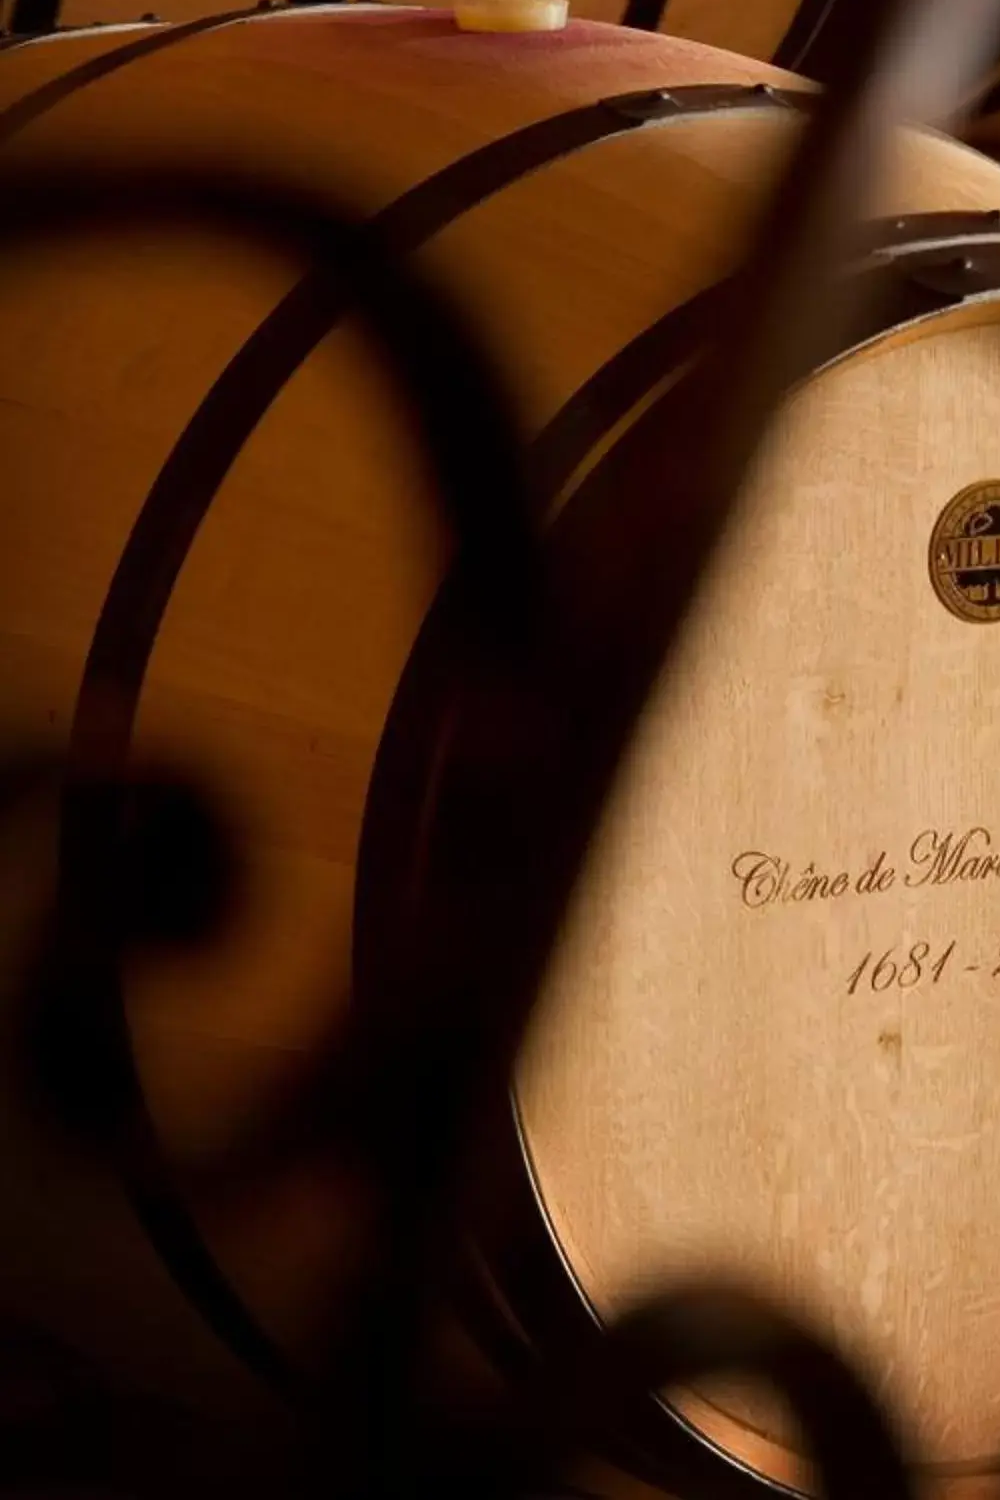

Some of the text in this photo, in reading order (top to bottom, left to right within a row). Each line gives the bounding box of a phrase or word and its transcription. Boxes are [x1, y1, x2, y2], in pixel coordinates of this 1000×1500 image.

[731, 851, 849, 909] Chêne
[856, 851, 896, 895] de
[845, 940, 956, 996] 1681
